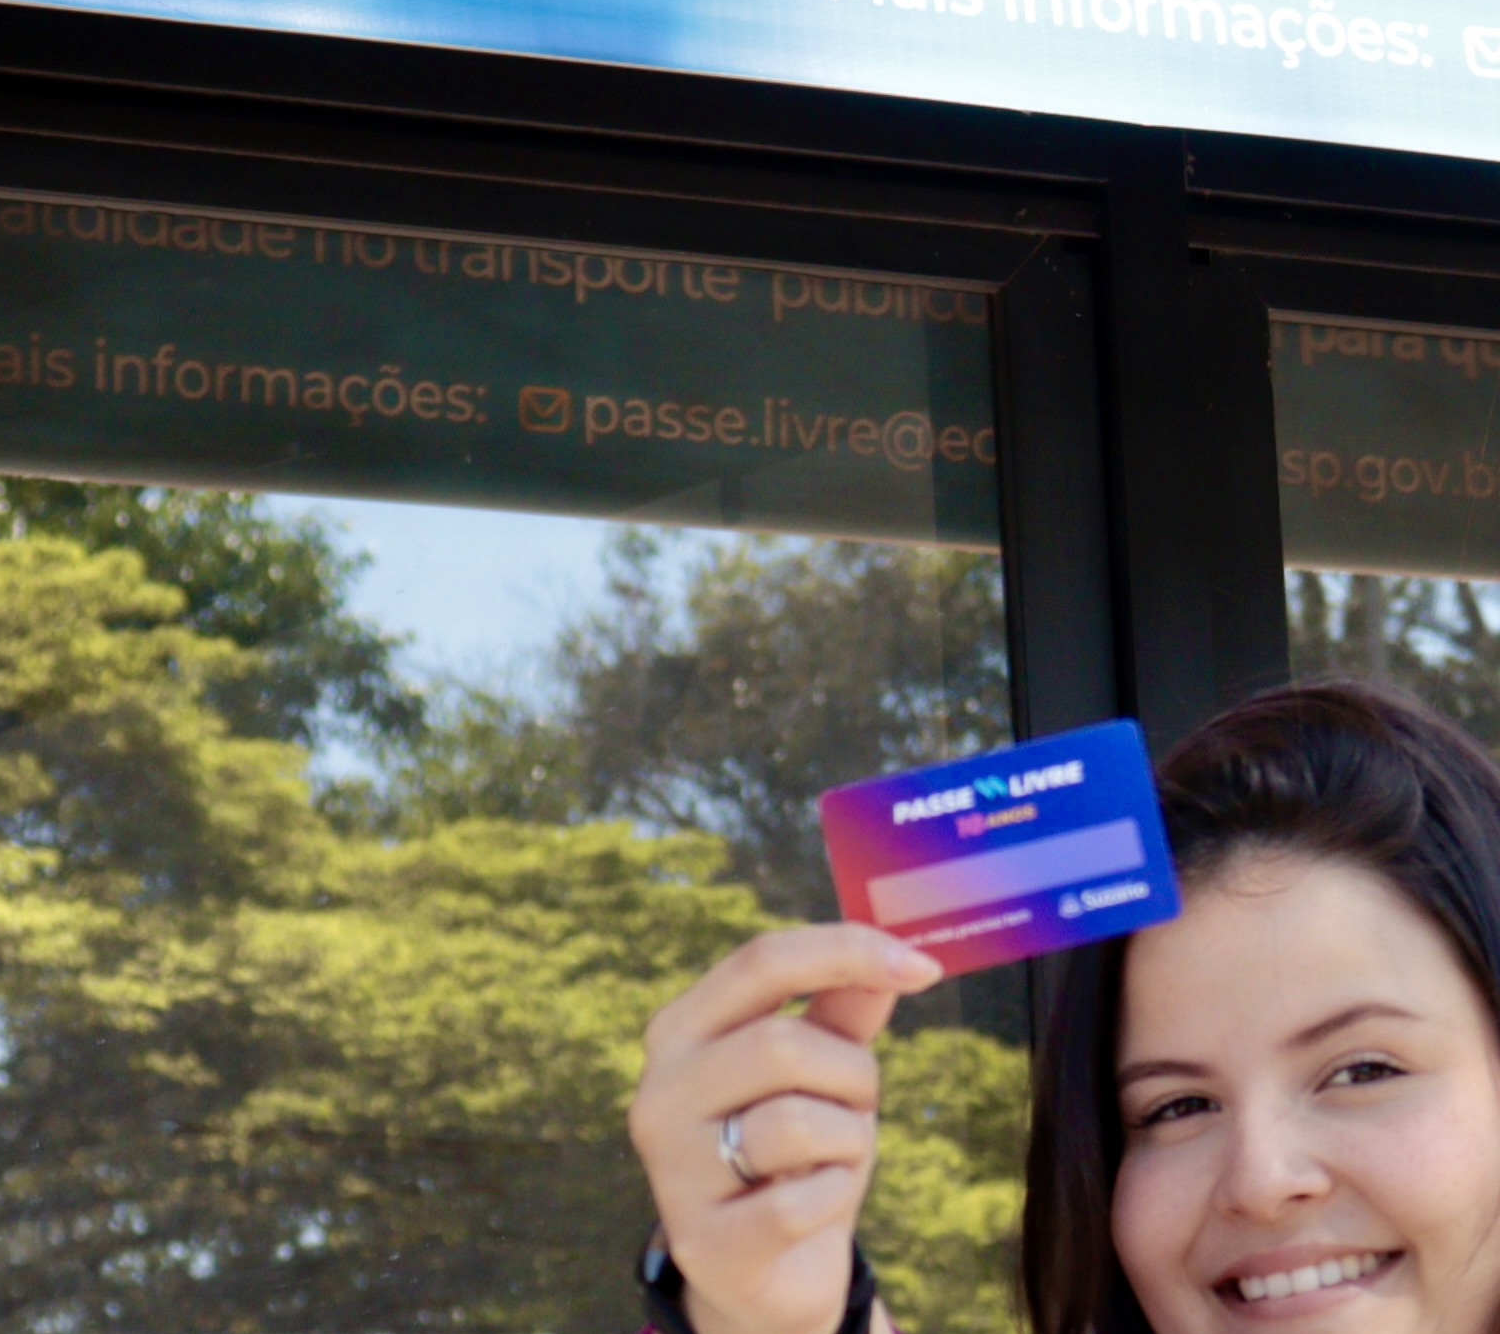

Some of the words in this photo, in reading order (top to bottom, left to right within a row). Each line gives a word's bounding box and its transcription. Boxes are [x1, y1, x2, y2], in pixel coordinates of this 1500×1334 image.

[96, 338, 487, 428] informações:
[893, 786, 975, 826] PASSE
[1008, 759, 1084, 798] LIVRE
